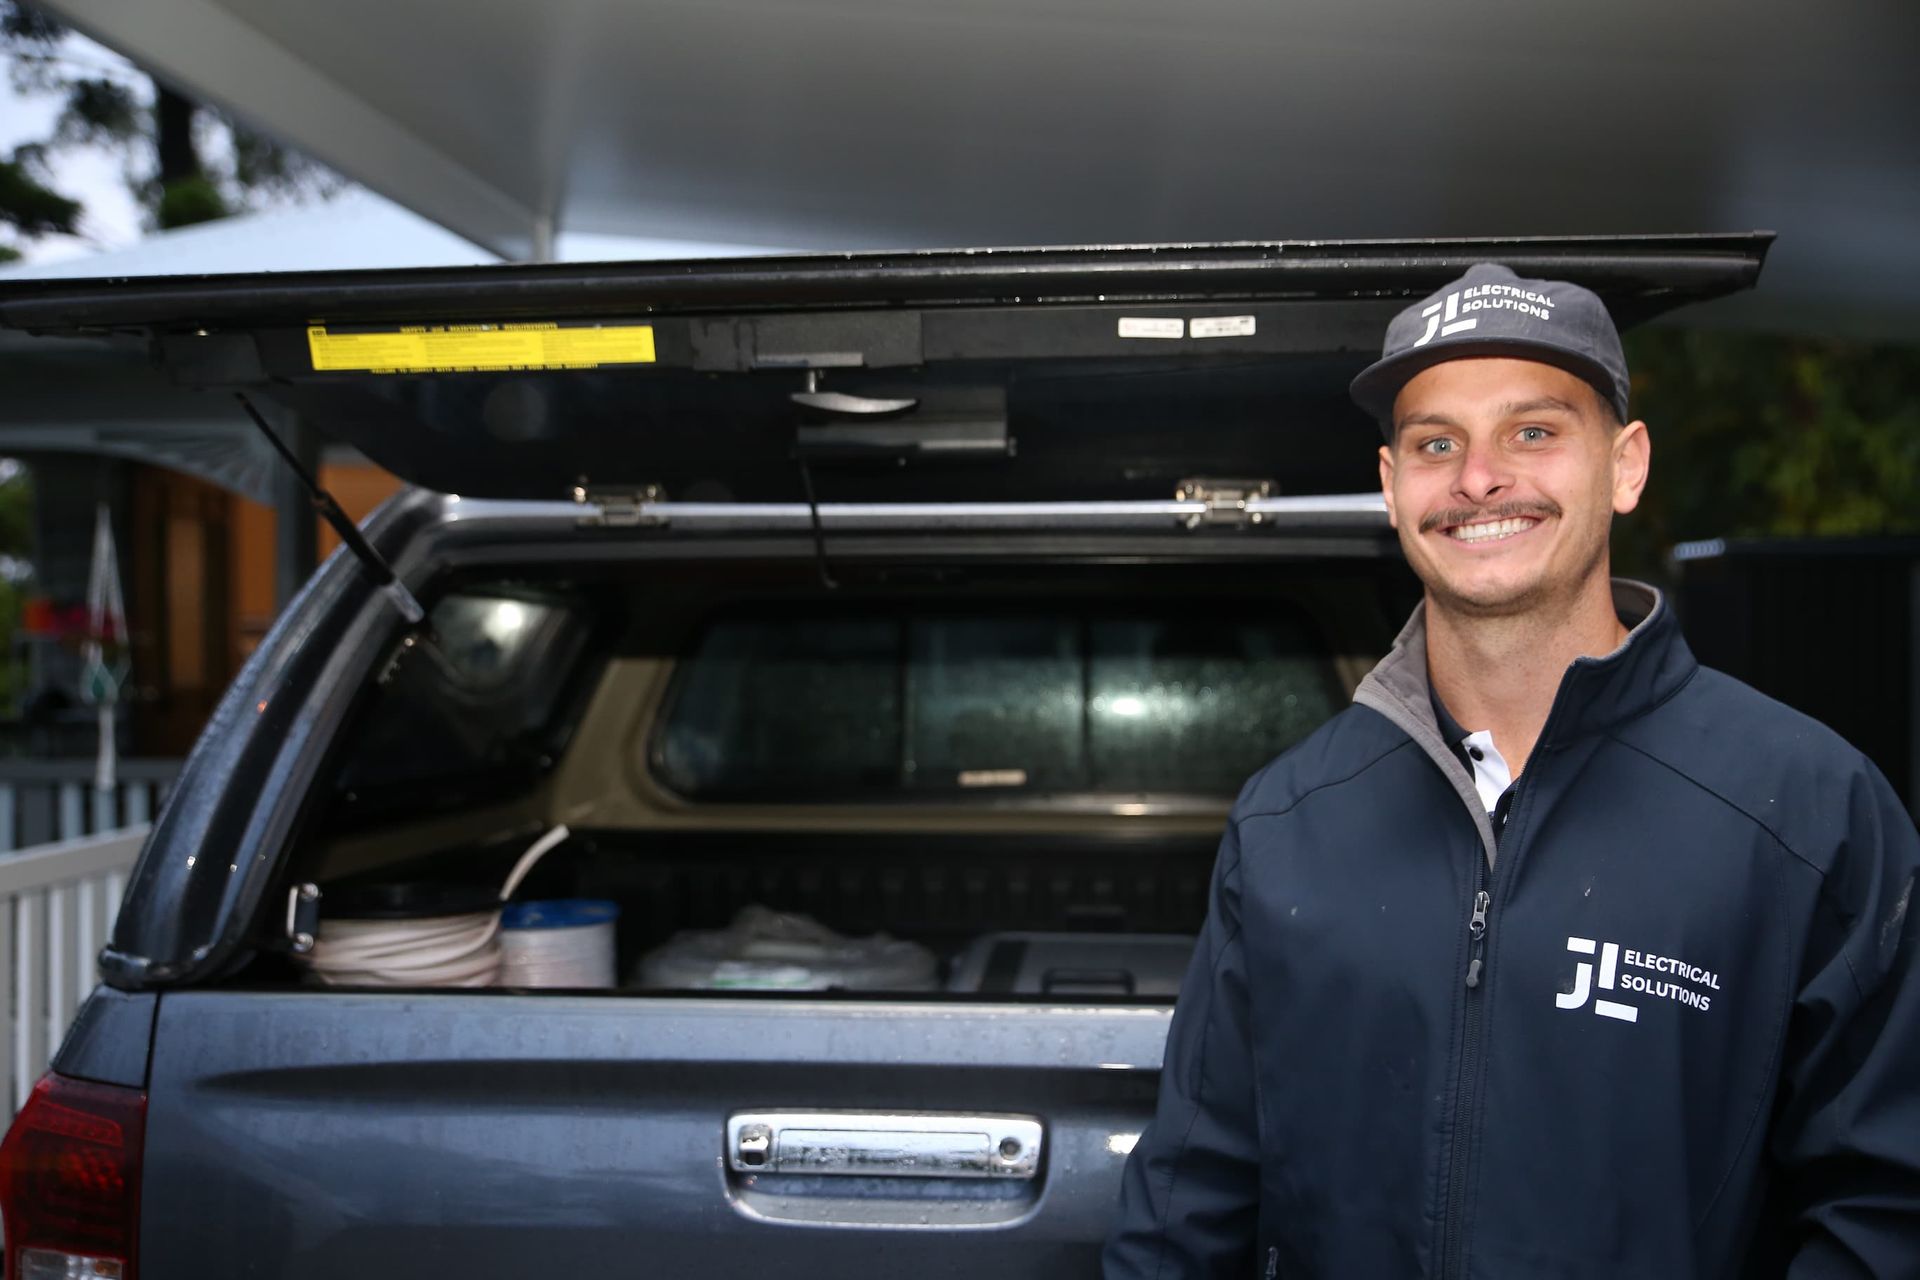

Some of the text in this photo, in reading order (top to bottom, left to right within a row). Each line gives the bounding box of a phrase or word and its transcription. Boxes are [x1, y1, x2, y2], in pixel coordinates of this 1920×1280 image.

[1462, 298, 1550, 321] SOLUTIONS
[1463, 284, 1555, 308] ELECTRICAL
[1624, 949, 1721, 990] ELECTRICAL
[1620, 974, 1711, 1011] SOLUTIONS
